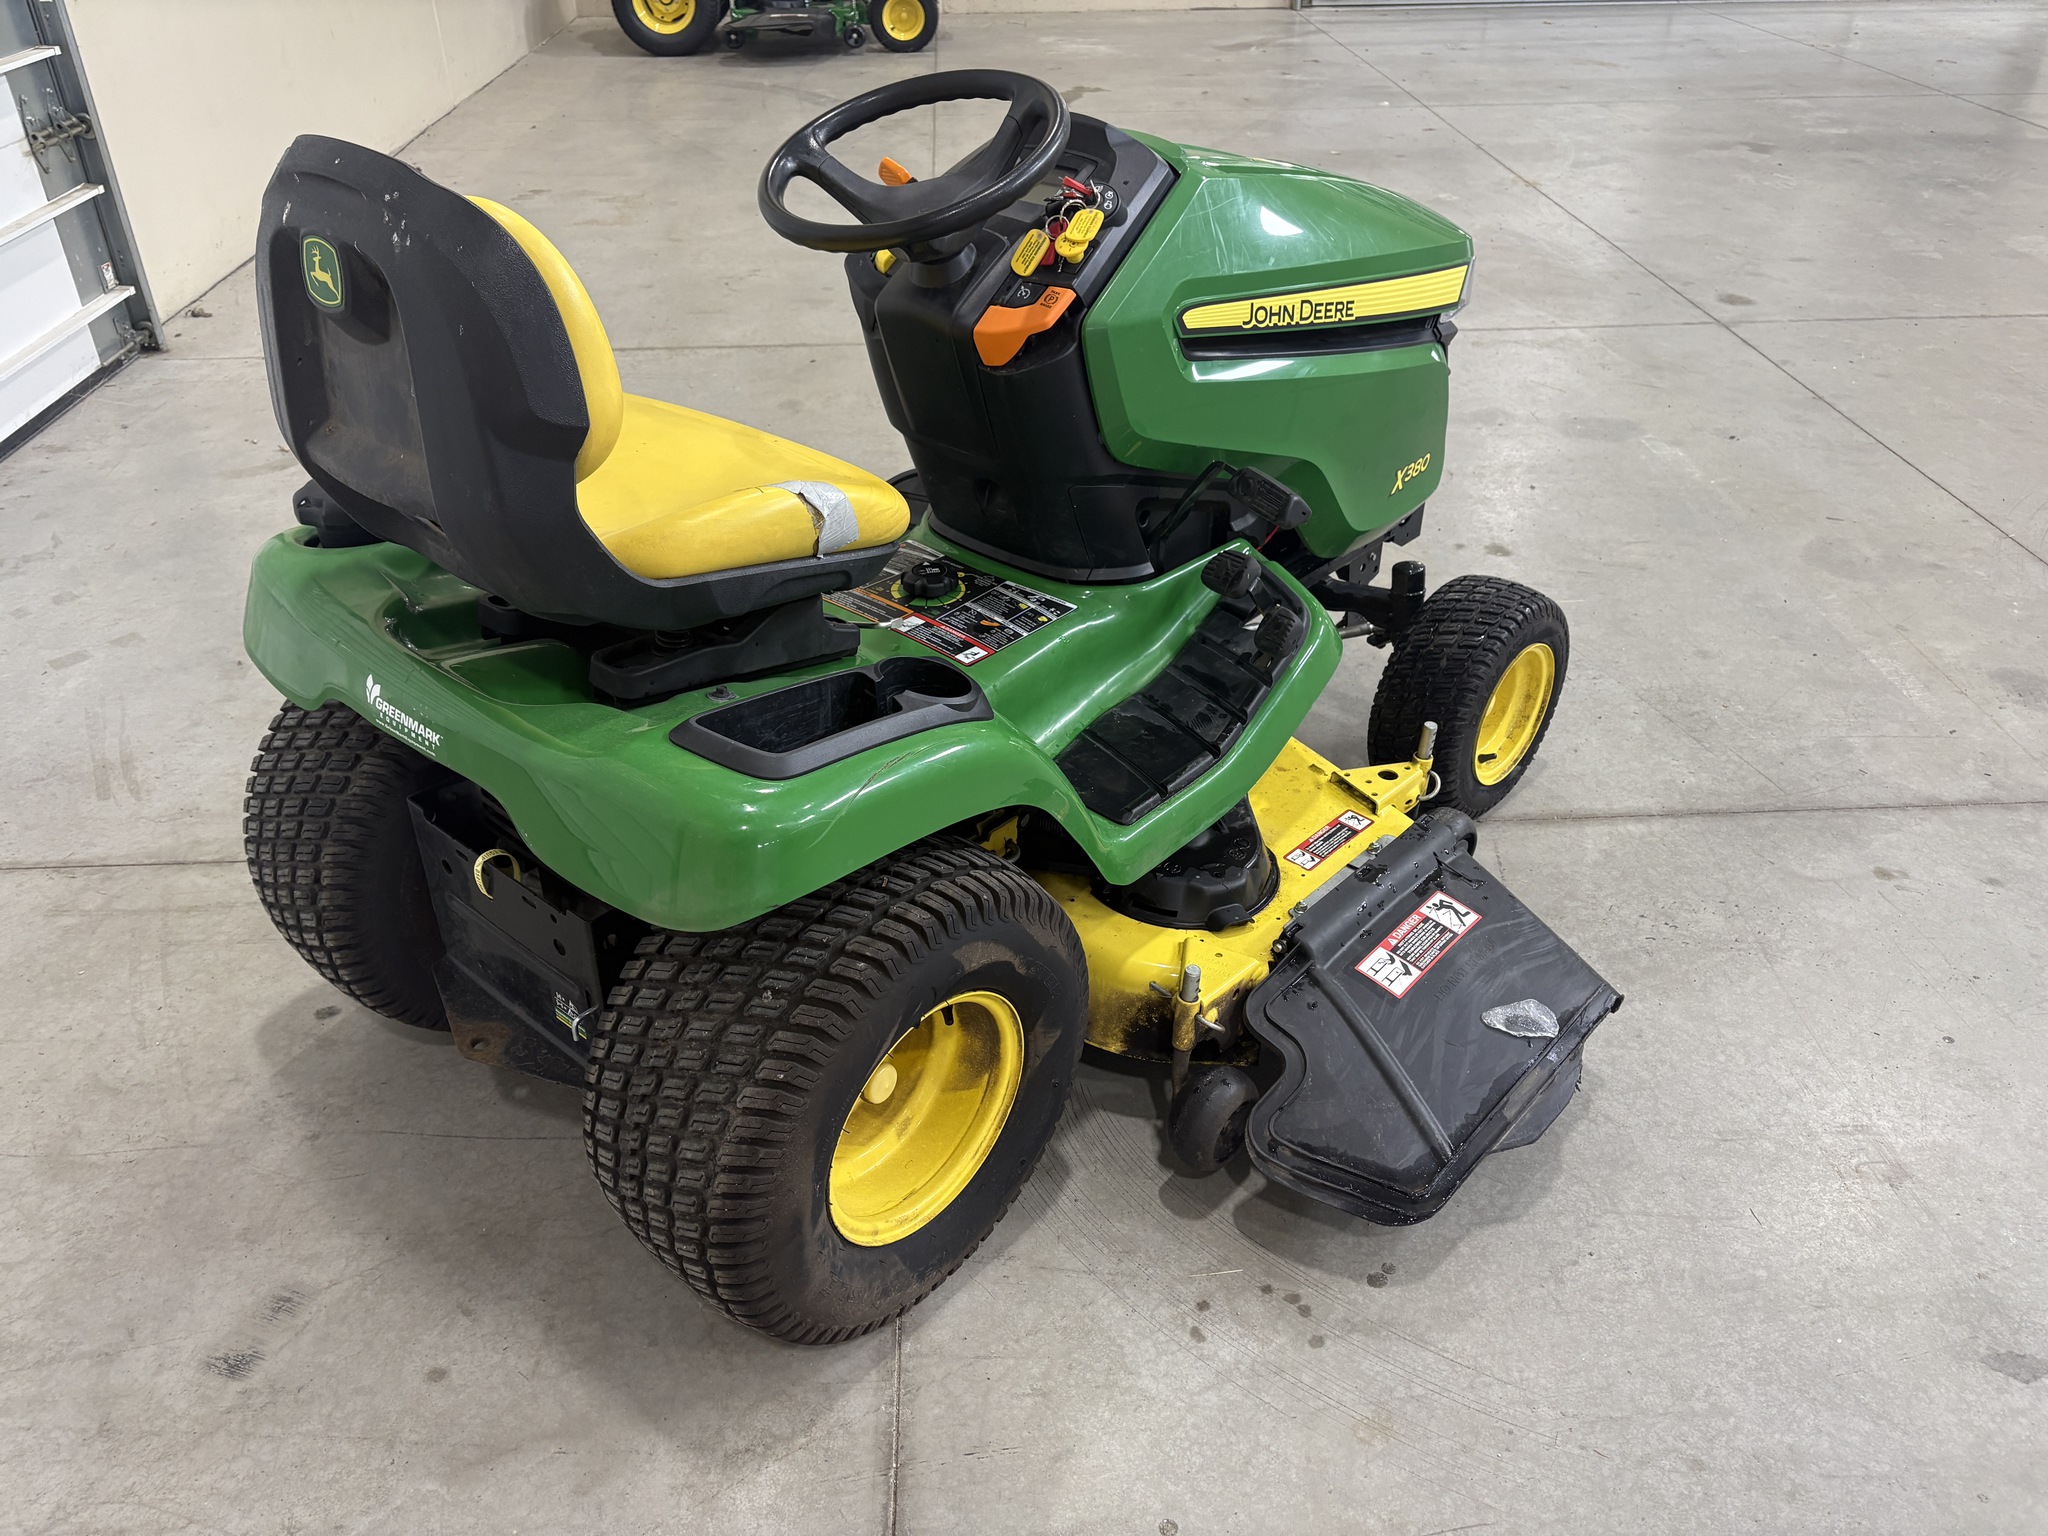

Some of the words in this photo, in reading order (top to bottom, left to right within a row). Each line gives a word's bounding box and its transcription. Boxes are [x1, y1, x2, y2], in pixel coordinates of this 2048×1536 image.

[1242, 302, 1295, 326] JOHN
[1299, 299, 1355, 322] DEERE
[1390, 452, 1431, 495] X380
[375, 697, 440, 747] GREENMARK
[379, 712, 435, 750] EQUIPMENT
[1392, 914, 1422, 939] DANGER
